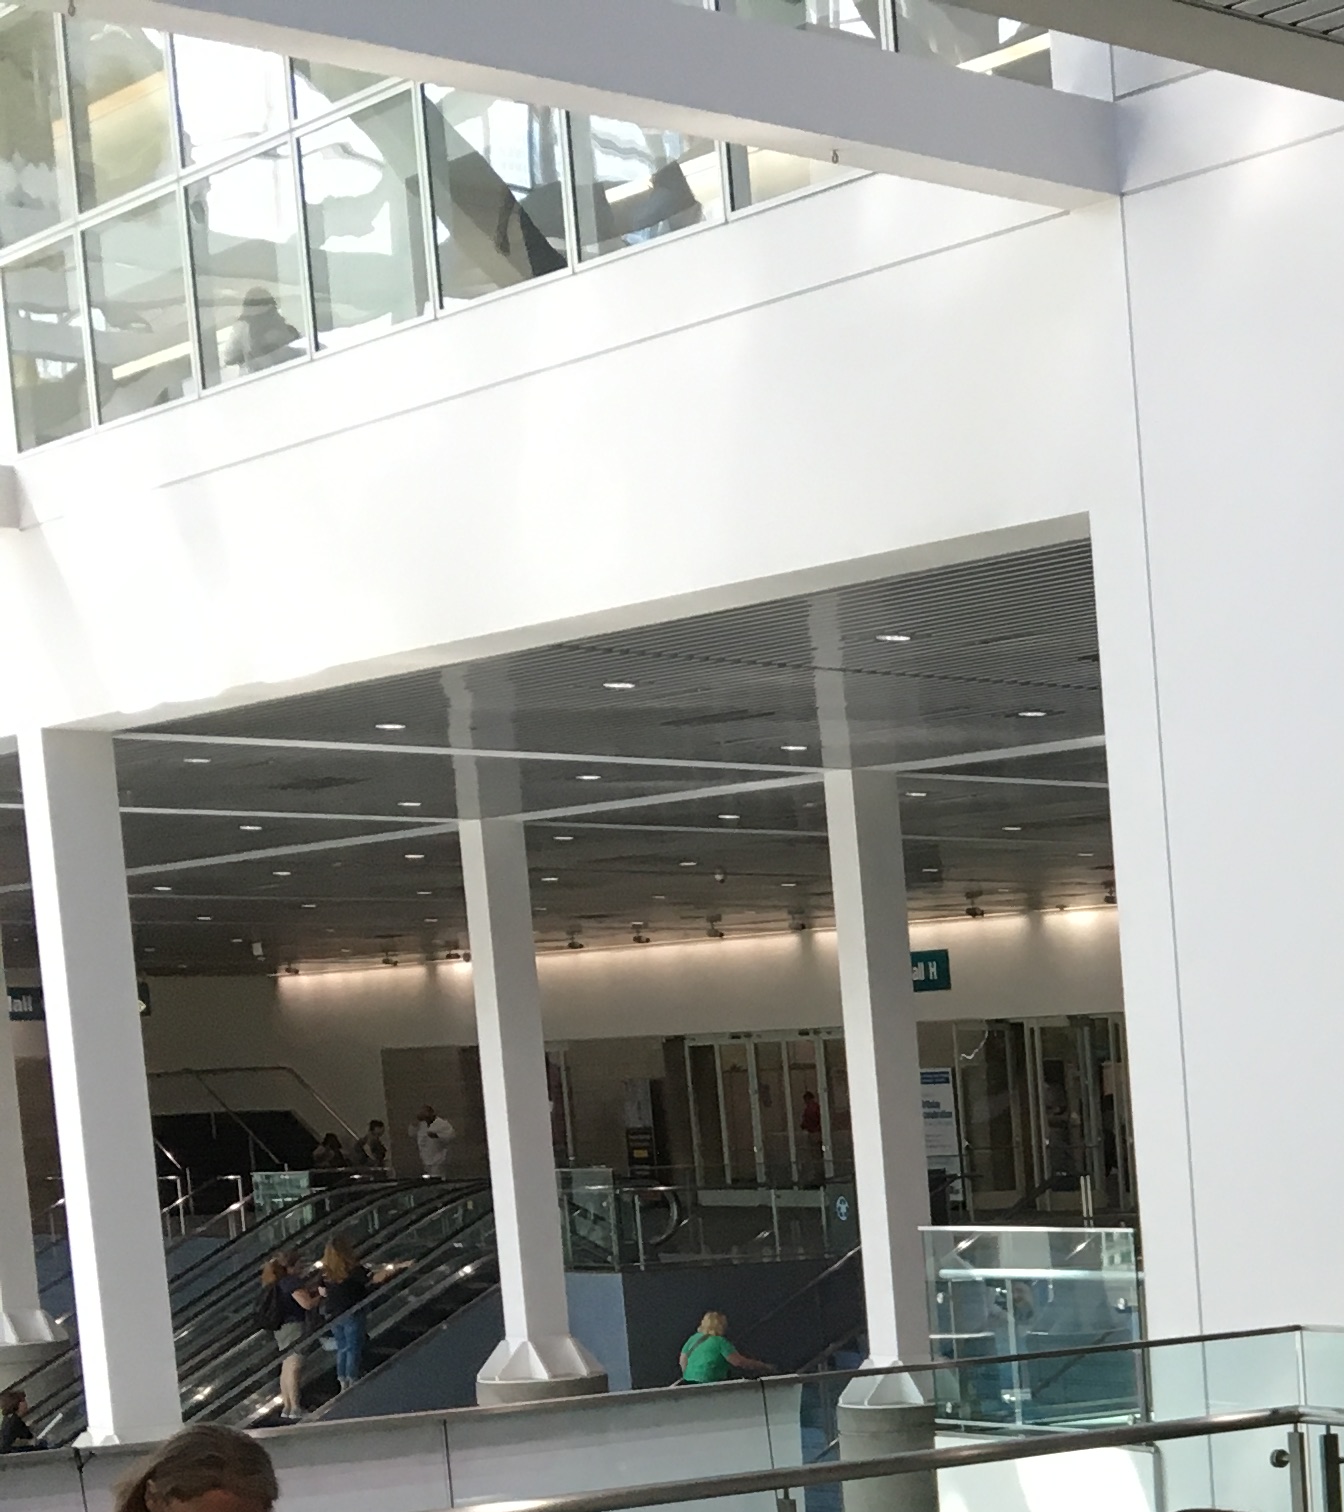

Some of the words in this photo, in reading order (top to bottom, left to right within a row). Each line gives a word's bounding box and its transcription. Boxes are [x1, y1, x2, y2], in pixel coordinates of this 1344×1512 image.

[912, 961, 925, 981] all
[928, 961, 938, 980] H
[7, 994, 33, 1012] all
